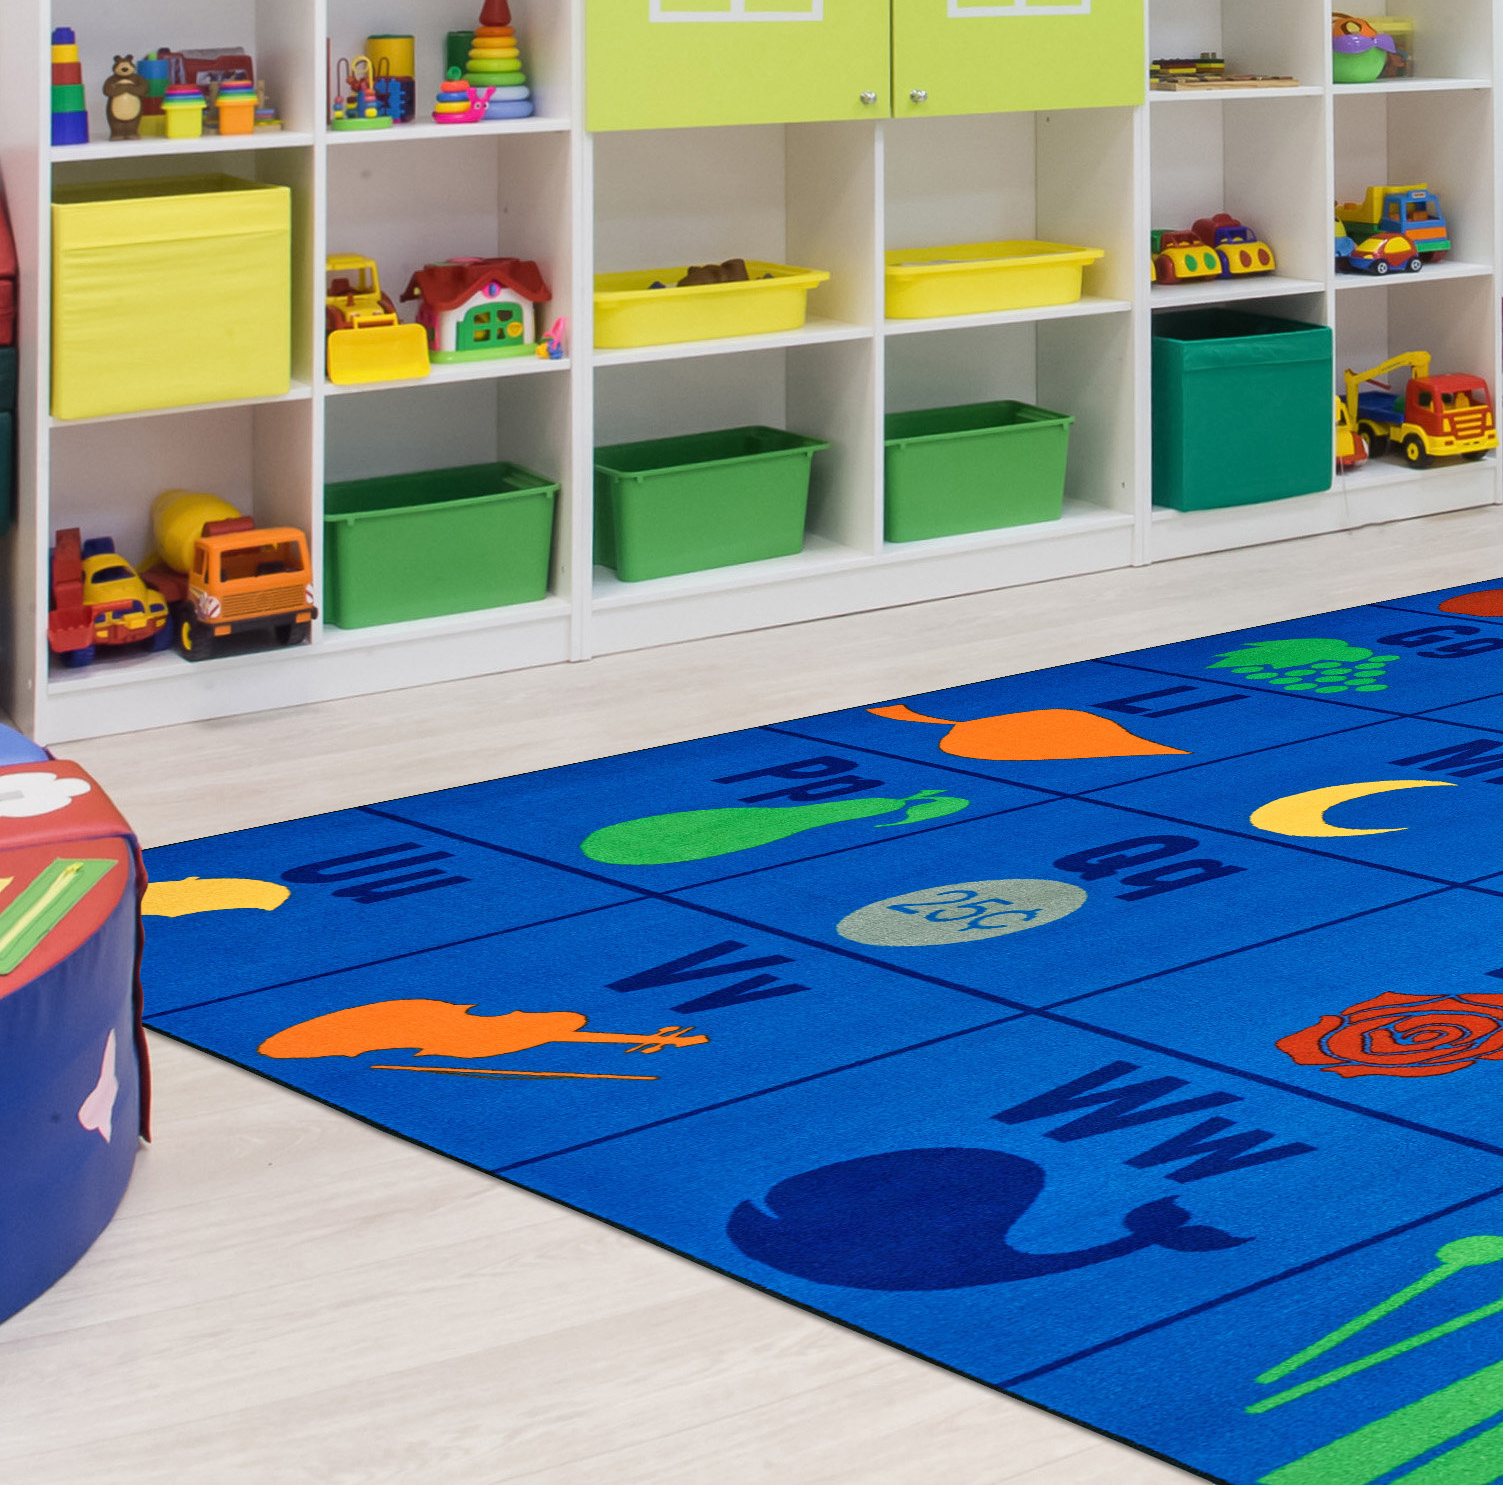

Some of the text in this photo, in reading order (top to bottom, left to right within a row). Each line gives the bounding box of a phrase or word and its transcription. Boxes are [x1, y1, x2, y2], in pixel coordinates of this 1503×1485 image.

[709, 755, 885, 804] Pp
[279, 841, 472, 905] Uu
[1052, 834, 1249, 903] Qq
[886, 889, 1043, 932] 25¢
[603, 939, 812, 1015] Vv
[989, 1059, 1318, 1185] Ww
